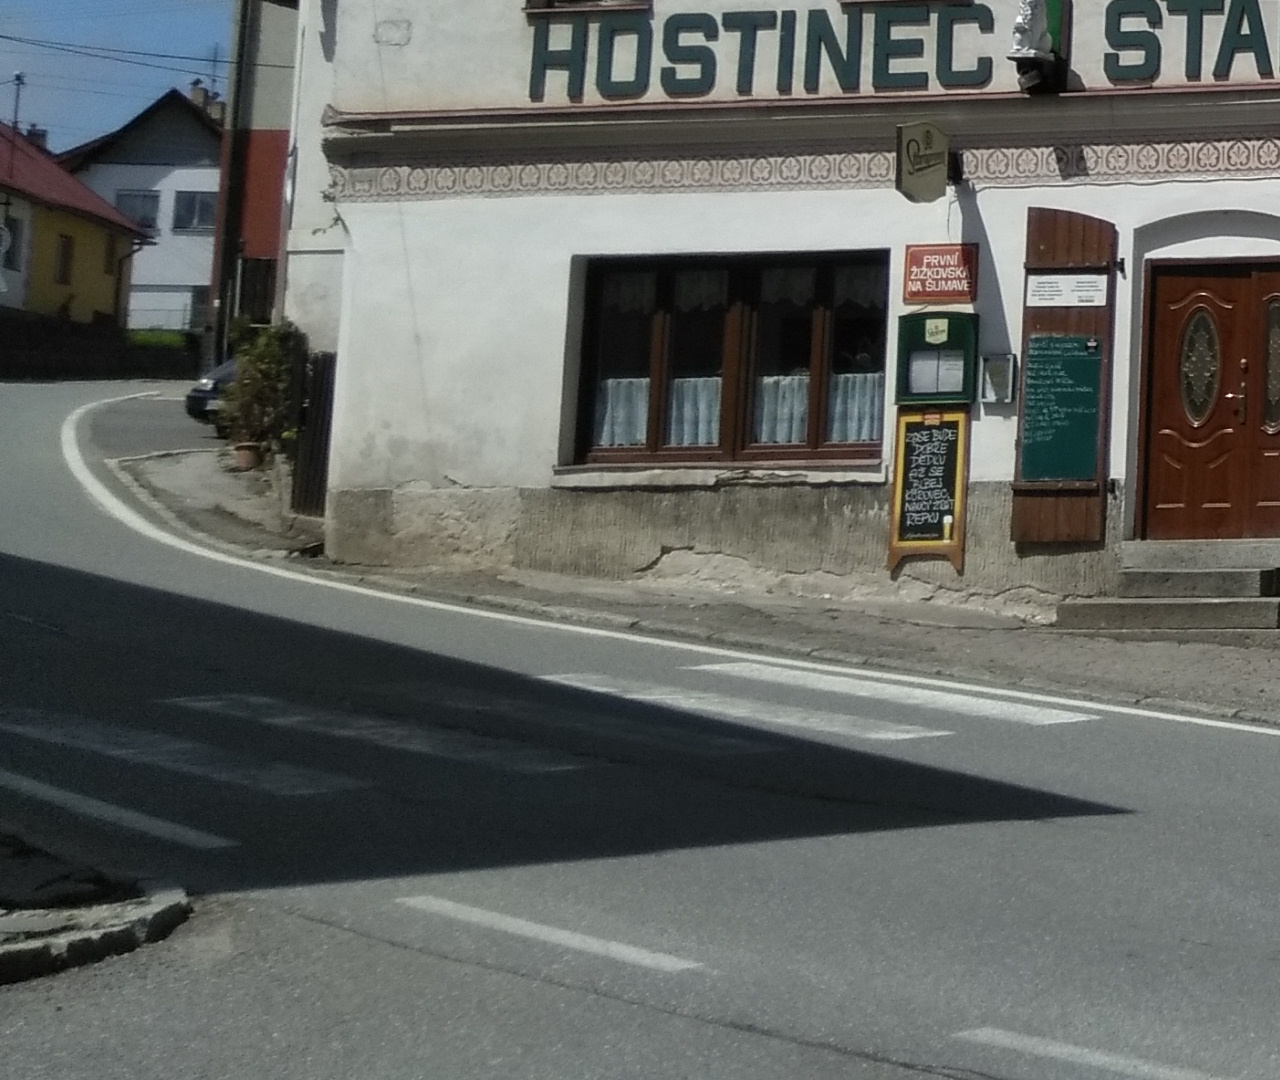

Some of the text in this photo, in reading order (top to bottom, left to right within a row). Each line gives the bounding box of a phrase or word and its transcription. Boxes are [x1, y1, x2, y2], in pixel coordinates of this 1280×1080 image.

[529, 2, 995, 103] HOSTINEC
[923, 251, 960, 267] PRVNÍ
[908, 280, 923, 292] NA
